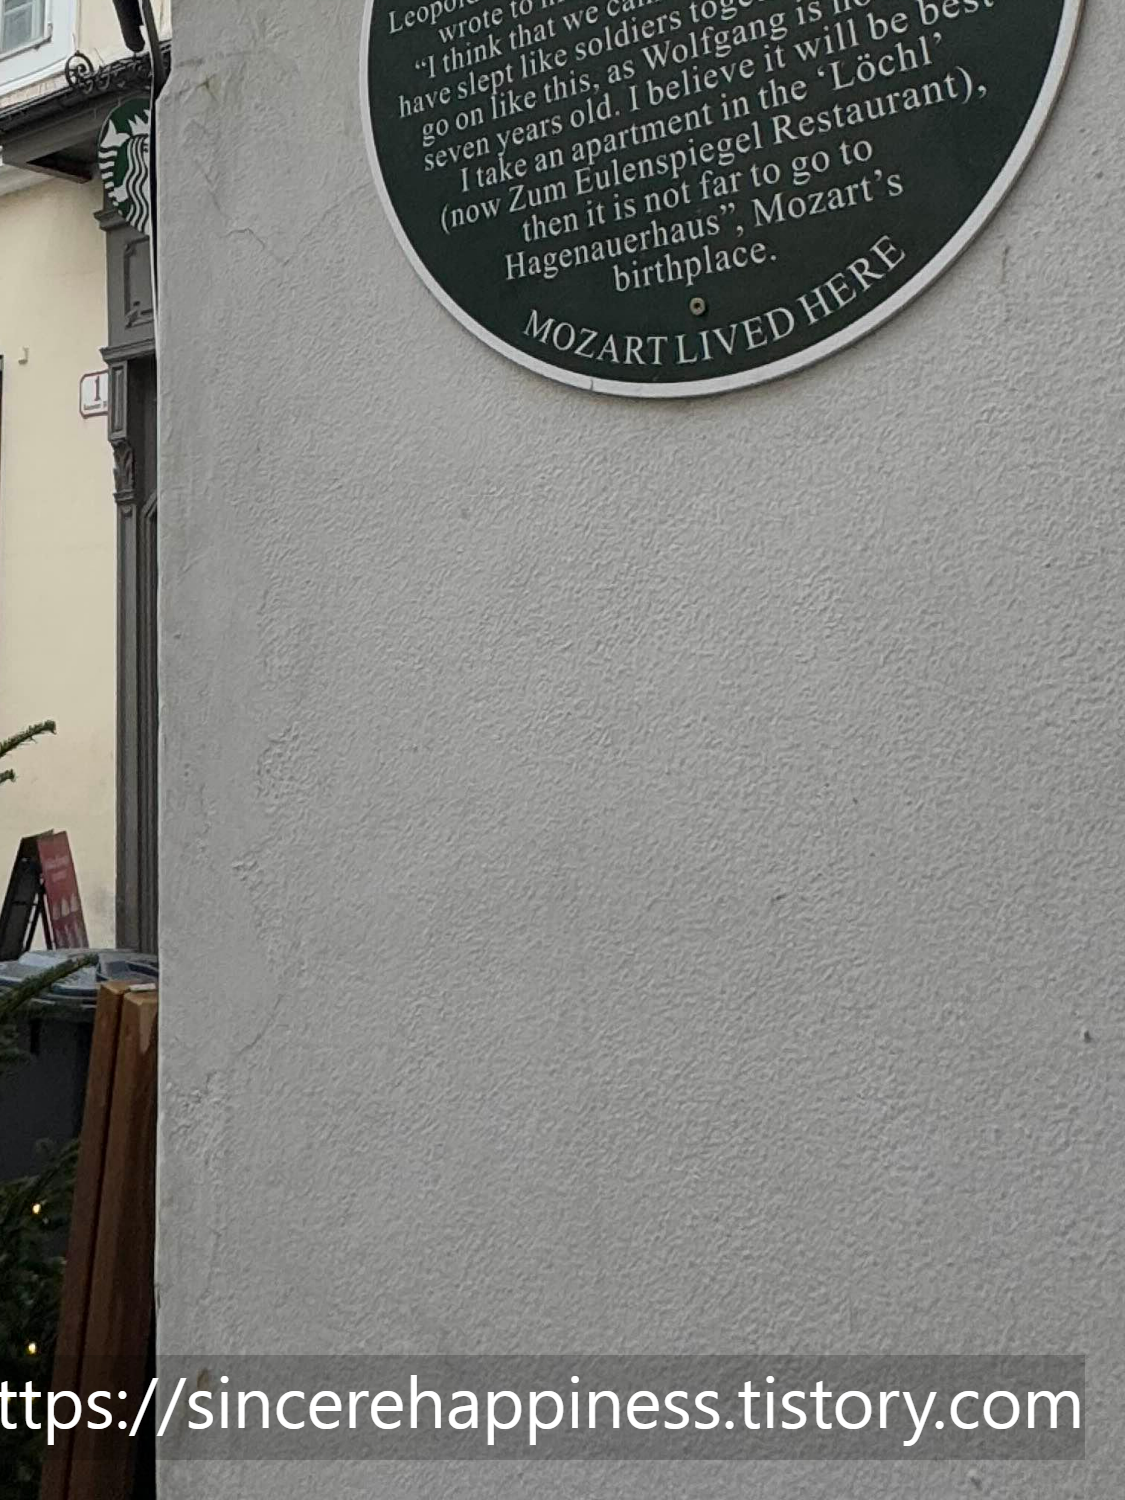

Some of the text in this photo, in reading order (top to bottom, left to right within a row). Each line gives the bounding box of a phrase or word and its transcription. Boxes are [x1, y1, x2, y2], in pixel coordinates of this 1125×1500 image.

[399, 87, 451, 119] have
[457, 63, 514, 95] slept
[520, 48, 567, 79] like
[575, 11, 682, 61] soldiers
[415, 54, 436, 79] “I
[442, 34, 503, 73] think
[509, 18, 556, 50] that
[562, 6, 598, 31] we
[422, 119, 449, 147] go
[455, 107, 484, 130] on
[490, 90, 537, 119] like
[543, 70, 600, 103] this,
[607, 60, 635, 84] as
[641, 12, 788, 70] Wolfgang
[438, 8, 503, 43] wrote
[424, 137, 490, 171] seven
[496, 115, 563, 156] years
[570, 92, 620, 128] old.
[629, 85, 640, 112] I
[646, 58, 755, 105] believe
[764, 44, 786, 73] it
[793, 18, 860, 61] will
[866, 12, 908, 40] be
[460, 32, 942, 193] I take an apartment in the ‘Löchl’
[441, 66, 987, 235] (now Zum Eulenspiegel Restaurant),
[522, 140, 873, 242] then it is not far to go to
[505, 169, 904, 280] Hagenauerhaus”, Mozart’s
[612, 243, 777, 292] birthplace.
[523, 235, 906, 365] MOZART LIVED HERE
